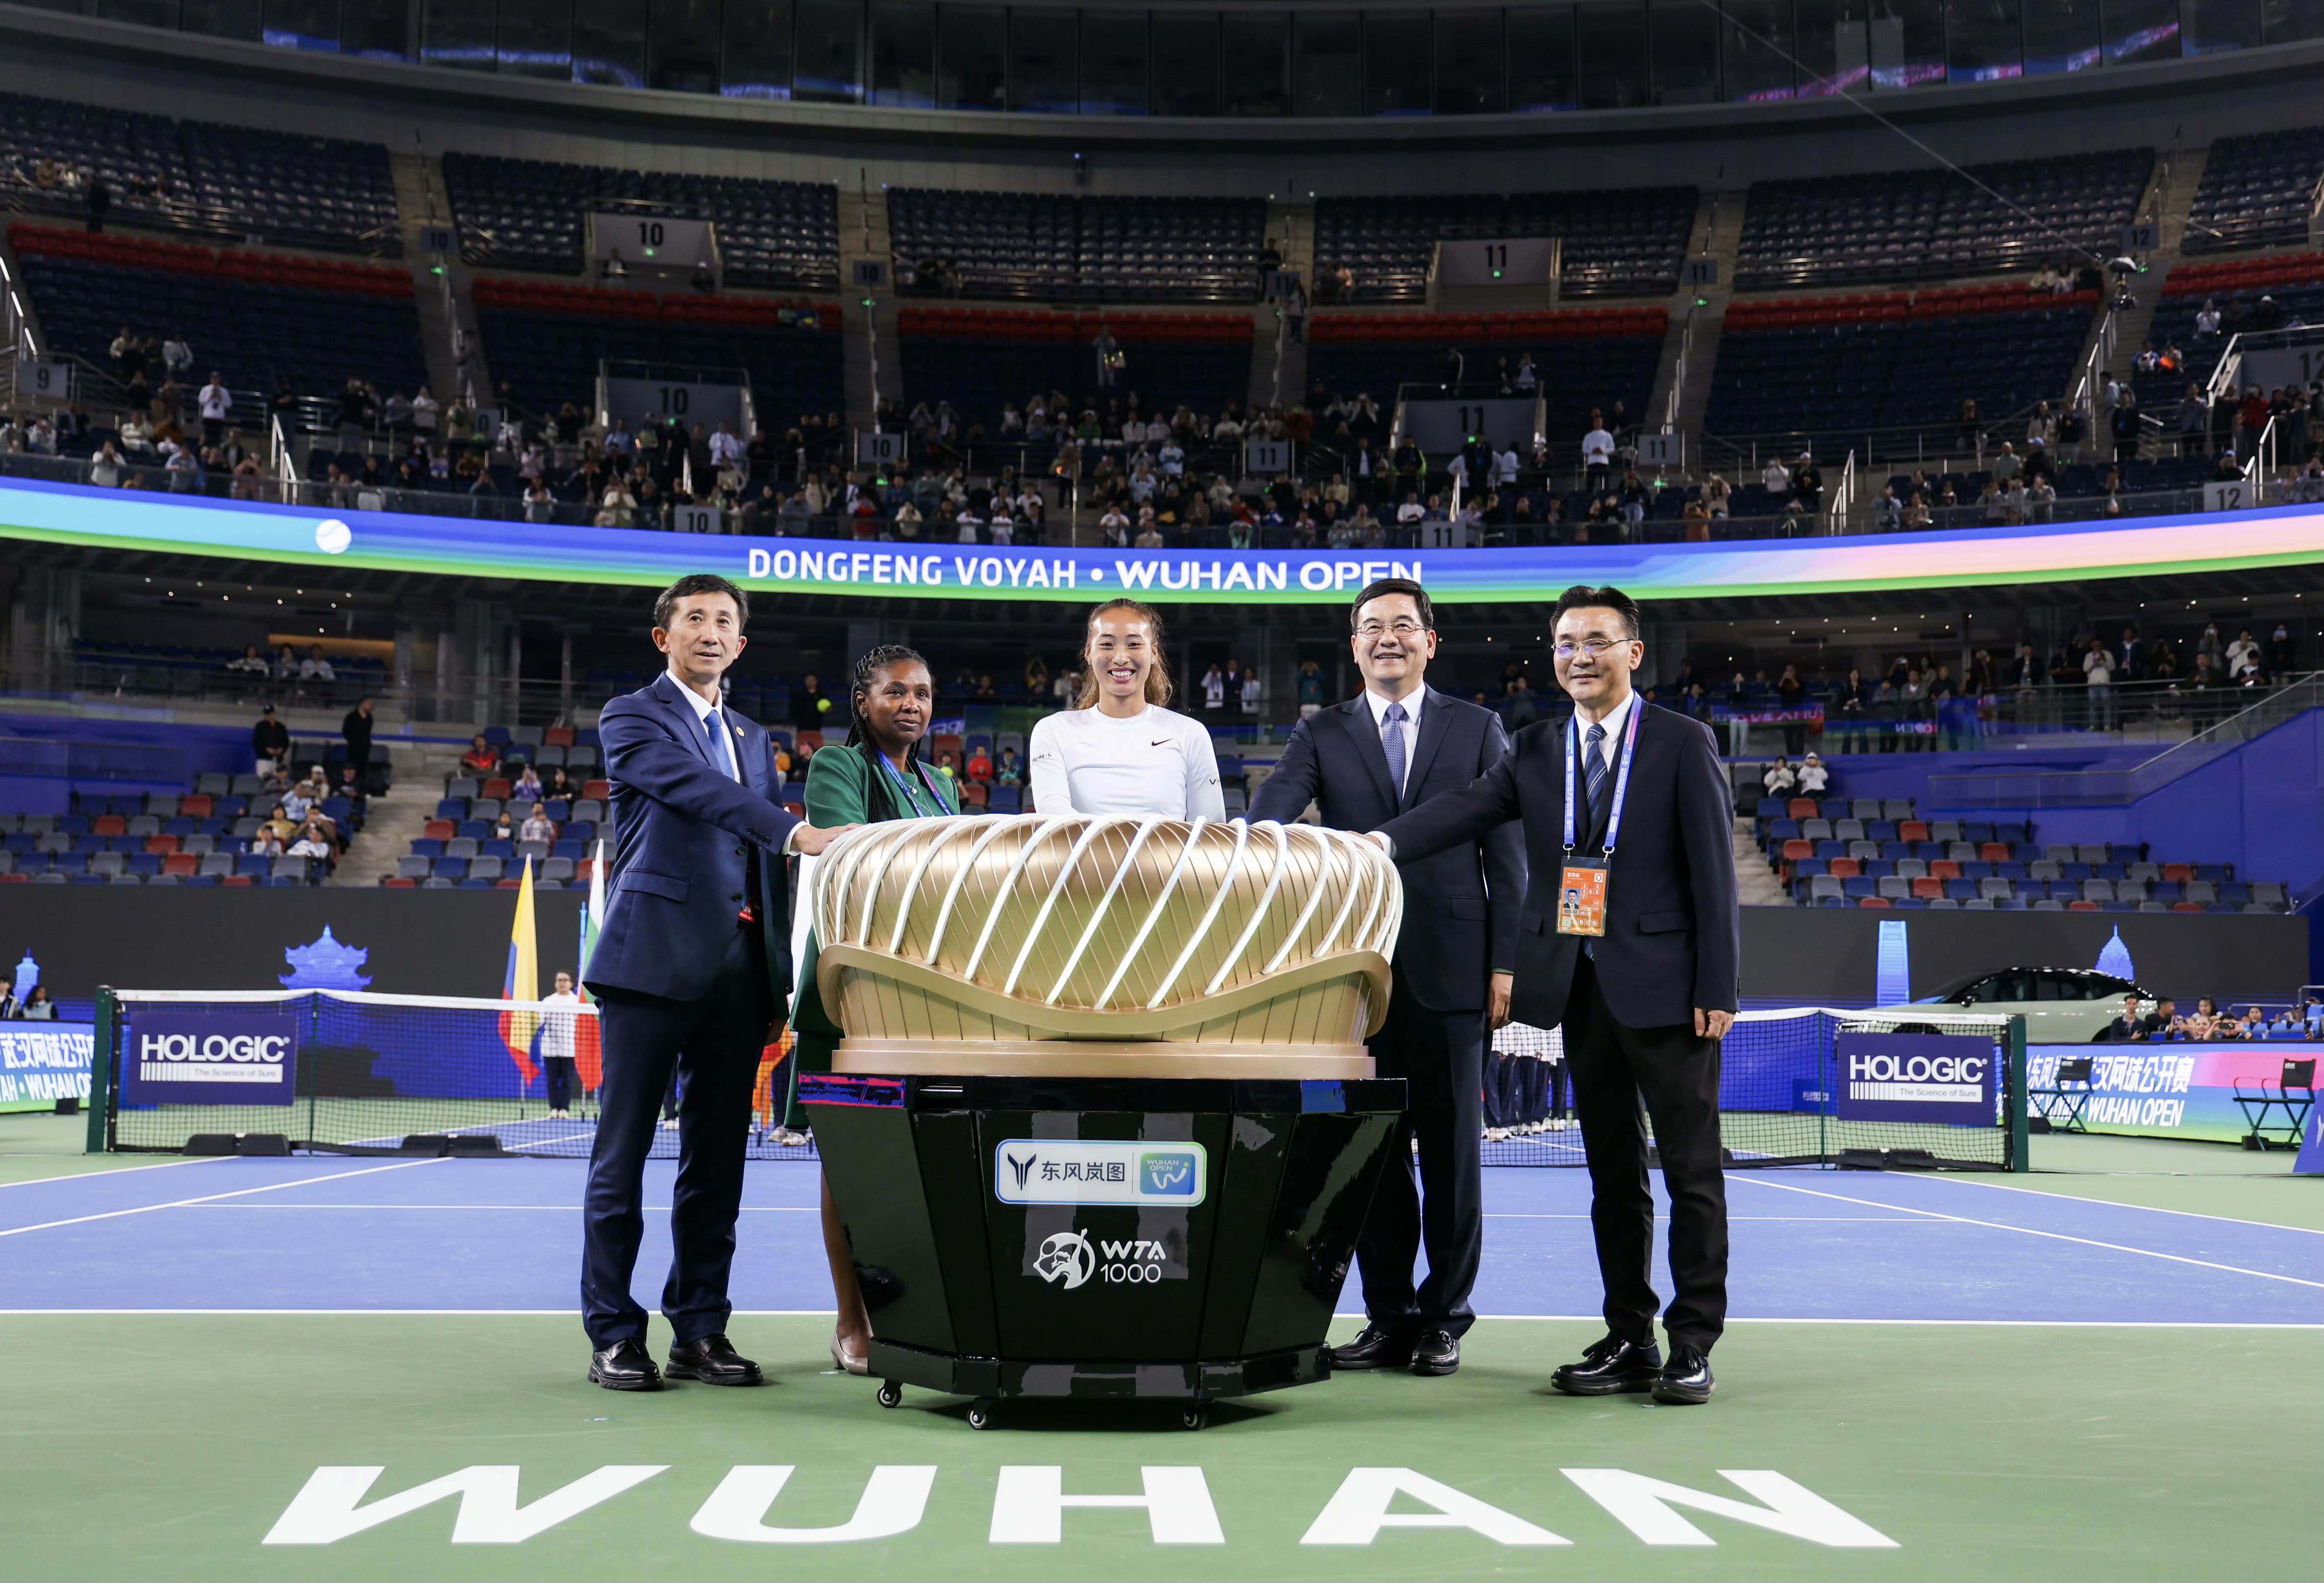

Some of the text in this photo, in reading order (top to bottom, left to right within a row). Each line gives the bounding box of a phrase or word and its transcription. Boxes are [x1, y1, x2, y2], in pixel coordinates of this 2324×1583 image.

[430, 231, 448, 249] 10
[638, 222, 663, 246] 10
[2131, 228, 2149, 246] 12
[1486, 244, 1506, 267] 11
[861, 265, 878, 281] 10
[1693, 264, 1706, 280] 11
[37, 369, 50, 390] 9
[660, 387, 688, 415] 10
[1459, 406, 1483, 433] 11
[872, 438, 891, 458] 10
[1259, 447, 1276, 465] 11
[1649, 440, 1666, 459] 11
[2216, 488, 2241, 509] 12
[687, 512, 708, 532] 10
[1433, 527, 1452, 547] 11
[749, 549, 942, 585] DONGFENG
[955, 557, 1076, 588] VOYAH
[1114, 561, 1287, 590] WUHAN
[211, 1068, 245, 1077] Science
[24, 1074, 79, 1100] WUHAN
[1916, 1088, 1948, 1097] Science
[1959, 1089, 1977, 1097] Sure
[2087, 1097, 2143, 1125] WUHAN
[2143, 1098, 2185, 1127] OPEN
[1041, 1160, 1125, 1182] 东风岚图
[1100, 1240, 1166, 1260] WTA
[1100, 1263, 1161, 1283] 1000
[261, 1465, 1903, 1547] WUHAN
